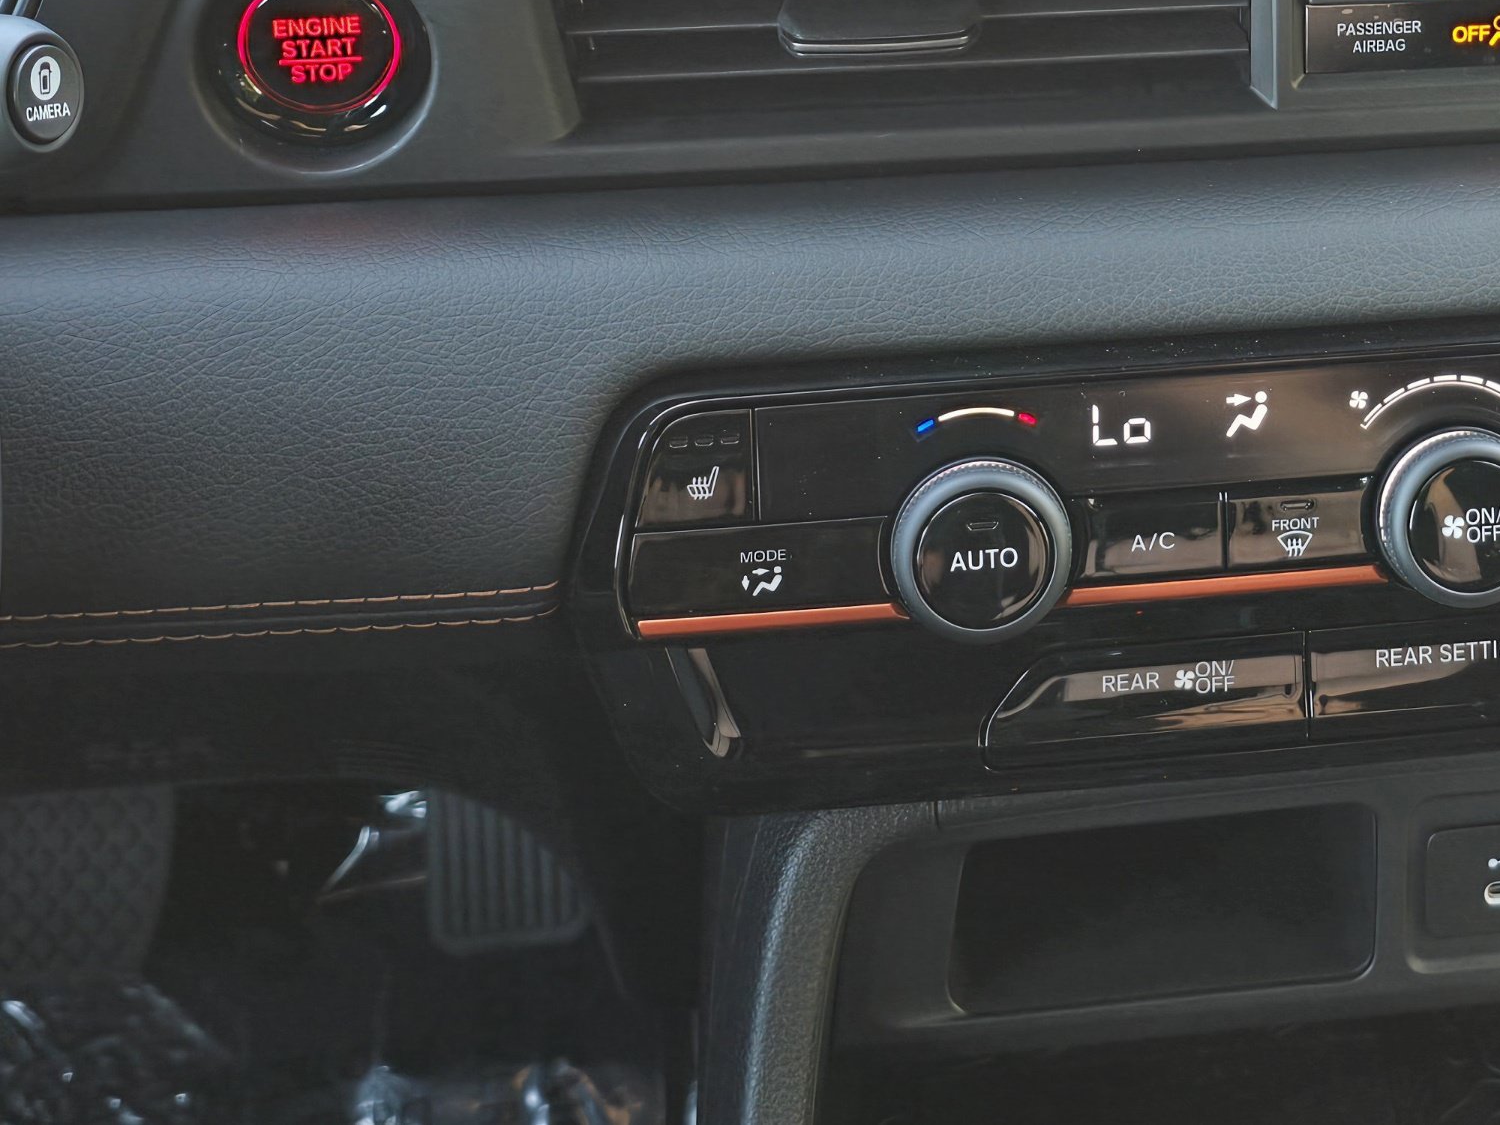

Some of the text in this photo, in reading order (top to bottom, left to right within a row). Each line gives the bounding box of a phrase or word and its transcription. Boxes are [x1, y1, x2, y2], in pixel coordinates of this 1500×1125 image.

[272, 15, 361, 39] ENGINE
[1337, 20, 1422, 37] PASSENGER
[1451, 24, 1491, 44] OFF
[282, 37, 356, 59] START
[1352, 38, 1406, 53] AIRBAG
[290, 62, 352, 83] STOP
[26, 102, 71, 123] CAMERA
[1091, 404, 1152, 447] Lo
[1271, 516, 1320, 531] FRONT
[1131, 531, 1176, 552] A/C
[739, 548, 787, 564] MODE
[950, 547, 1019, 572] AUTO
[1374, 644, 1433, 669] REAR
[1194, 659, 1236, 678] ON/
[1100, 672, 1160, 694] REAR
[1194, 676, 1236, 694] OFF
